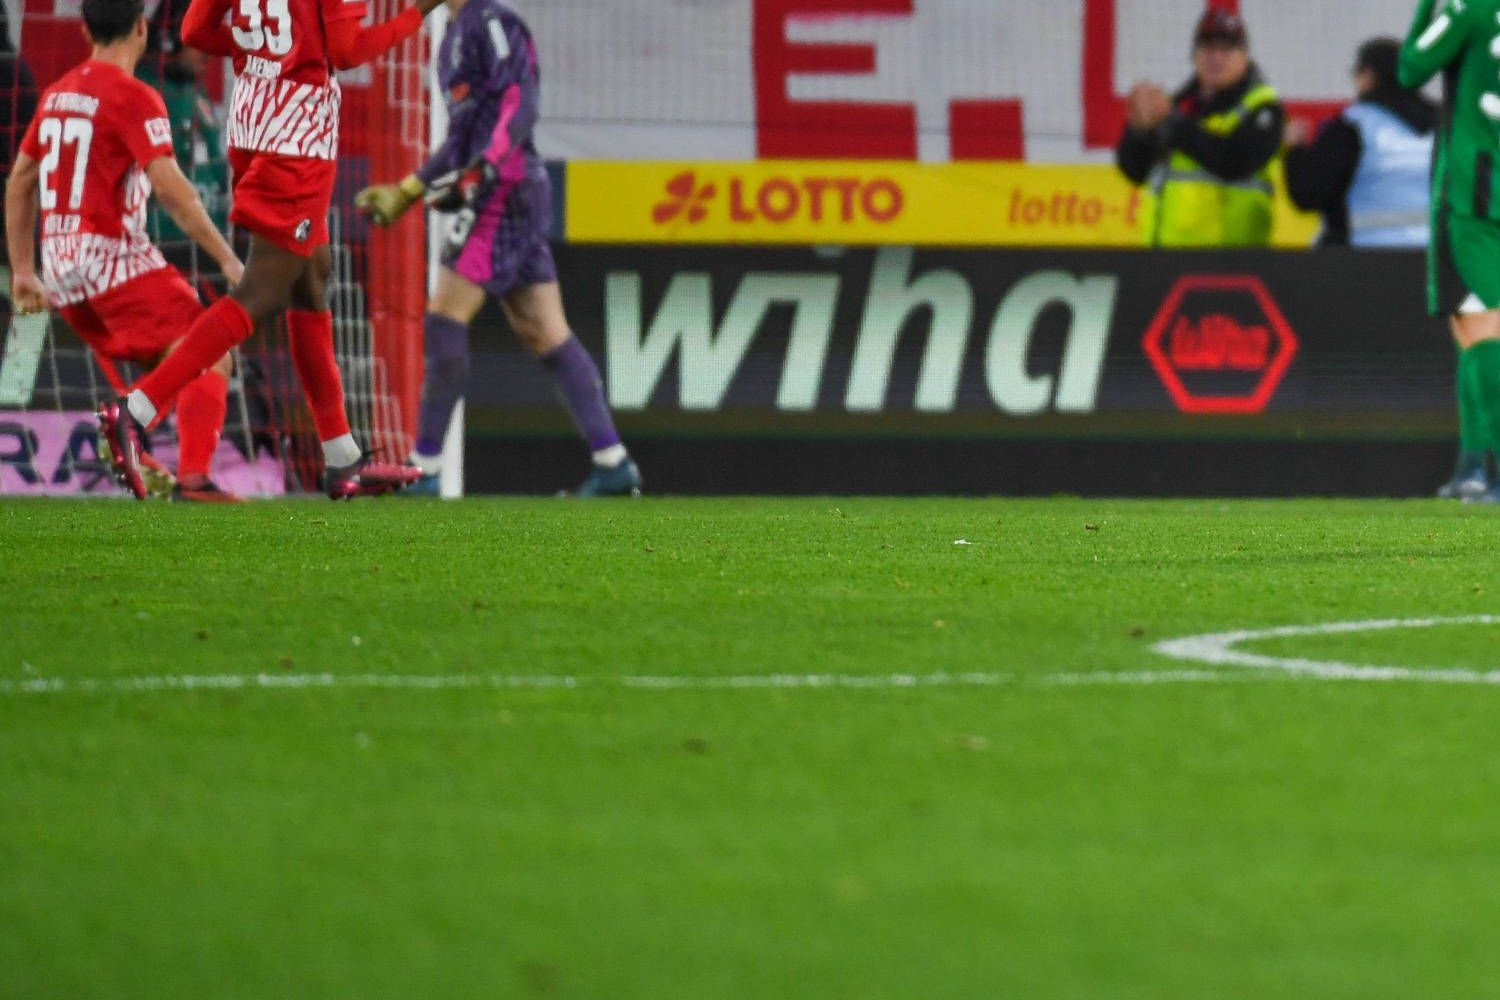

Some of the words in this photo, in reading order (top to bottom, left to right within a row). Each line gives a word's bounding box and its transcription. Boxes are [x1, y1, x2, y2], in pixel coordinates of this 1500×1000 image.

[39, 117, 94, 210] 27
[728, 177, 904, 223] LOTTO
[605, 244, 1119, 415] wiha
